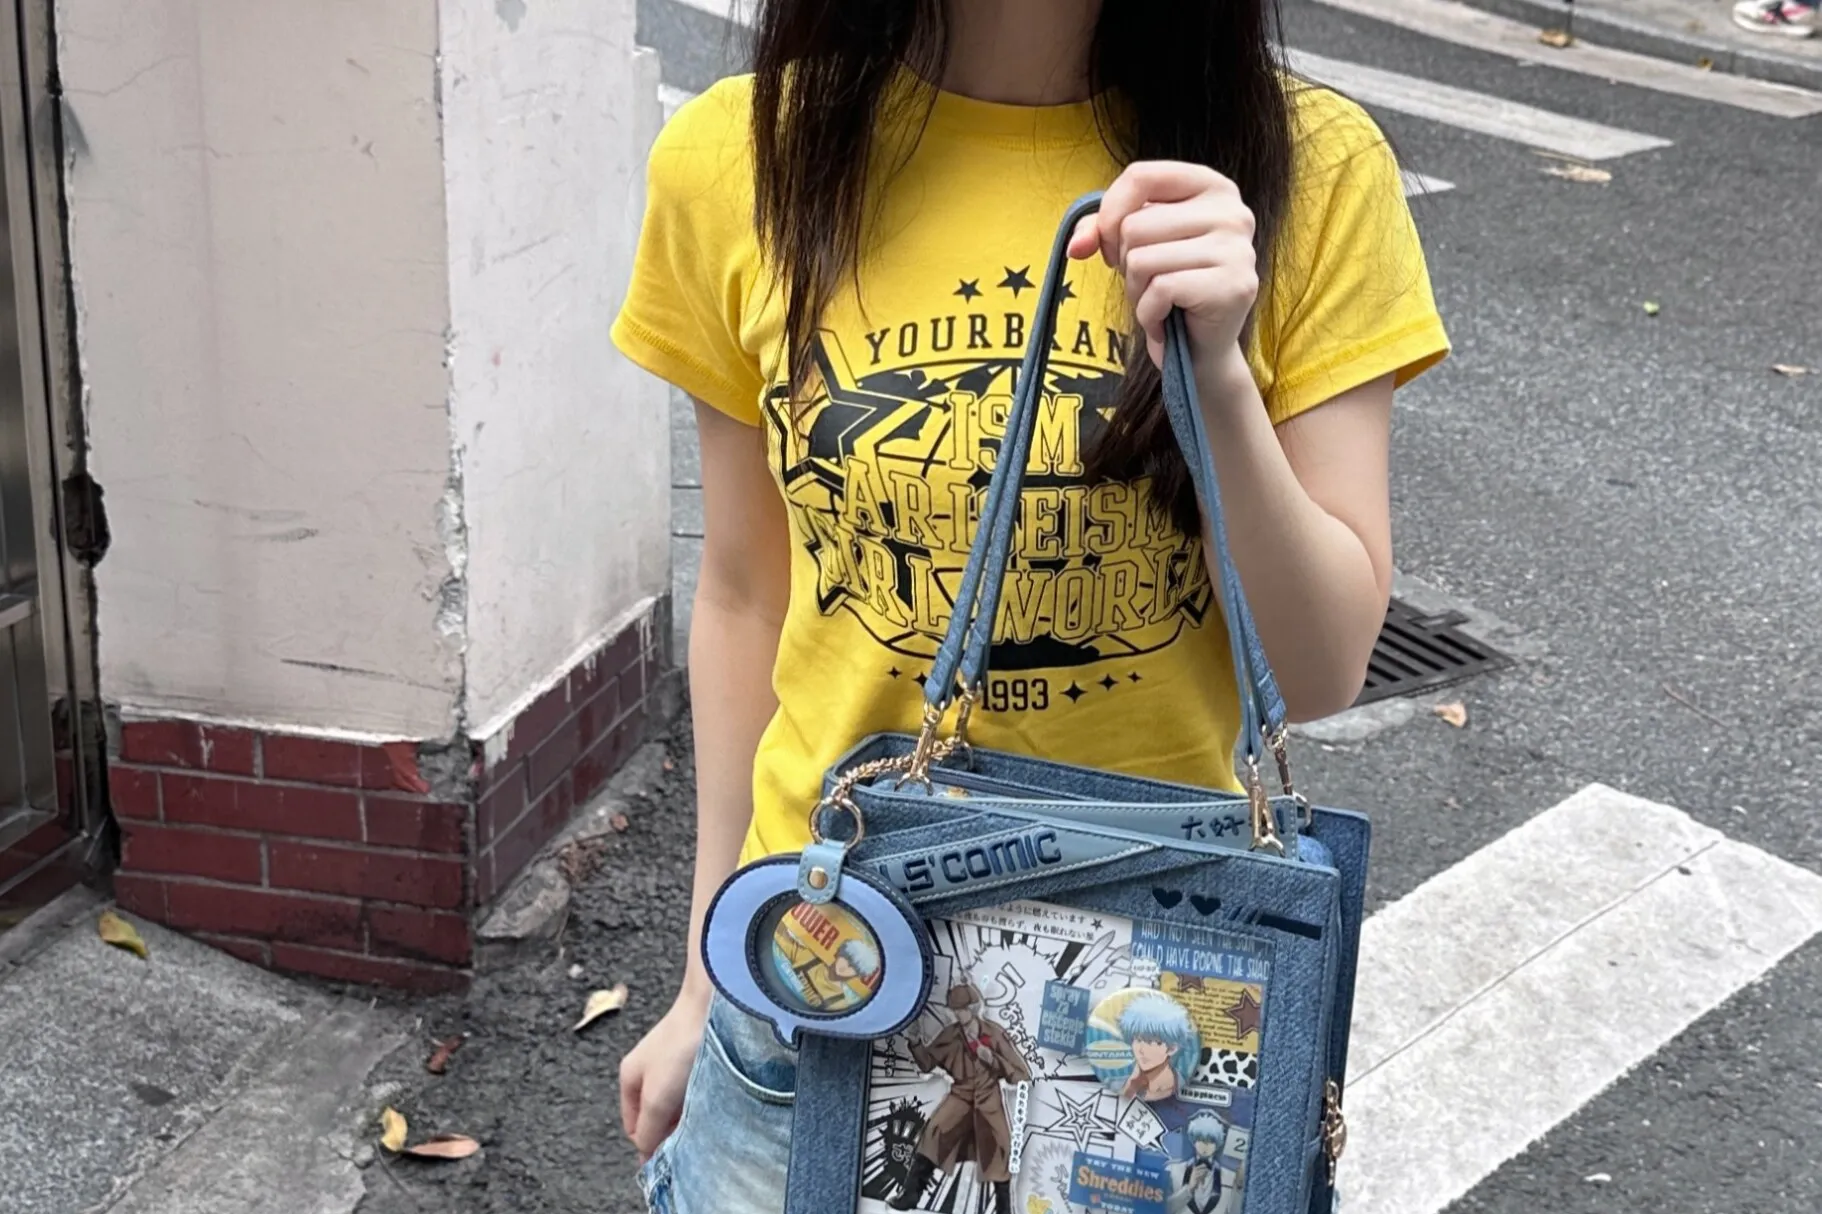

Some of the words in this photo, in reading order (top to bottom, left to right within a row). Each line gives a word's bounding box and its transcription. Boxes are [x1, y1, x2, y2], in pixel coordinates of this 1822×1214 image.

[865, 312, 1130, 367] YOURBAN
[948, 391, 1084, 476] ISM
[842, 455, 1184, 562] ARIEISM
[981, 678, 1050, 712] 1993
[1233, 1137, 1247, 1153] 2
[1076, 1164, 1165, 1204] Shreddies
